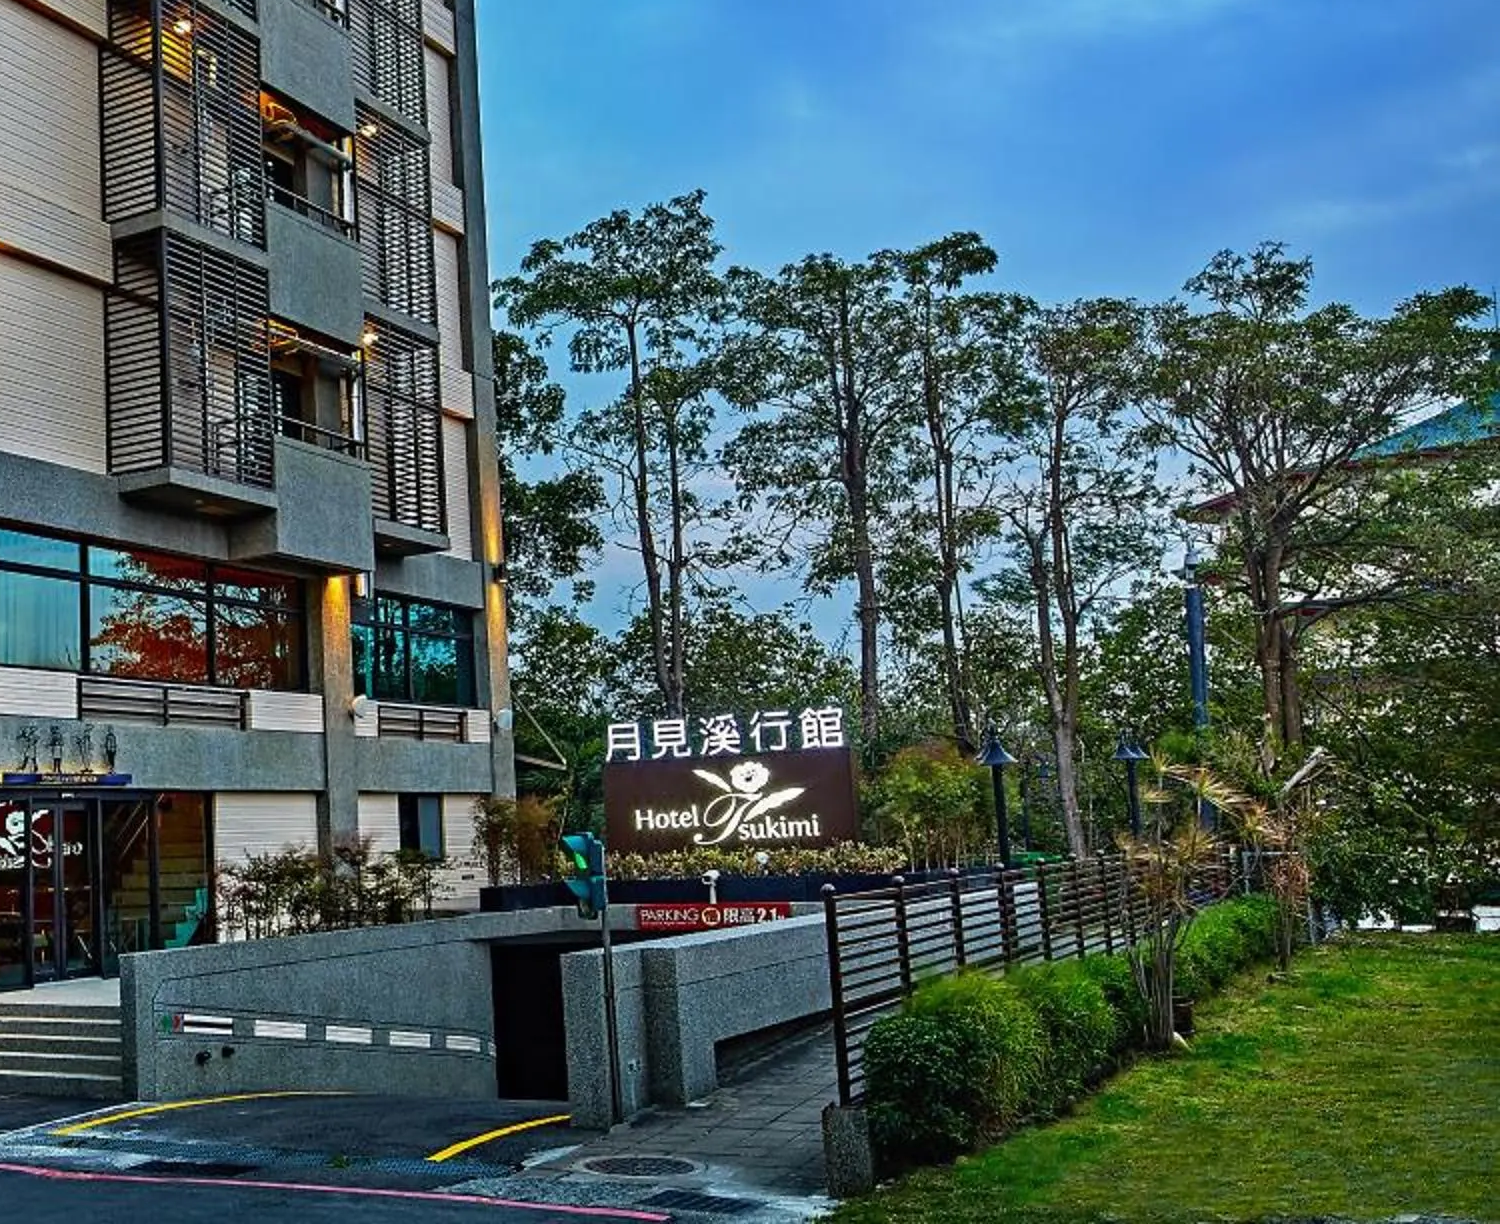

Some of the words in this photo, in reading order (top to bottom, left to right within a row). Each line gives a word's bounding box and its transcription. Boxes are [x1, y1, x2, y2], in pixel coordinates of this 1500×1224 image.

[605, 706, 844, 762] 月見溪行館
[634, 804, 700, 831] Hotel
[693, 791, 821, 845] Tsukimi
[639, 907, 700, 923] PARKING
